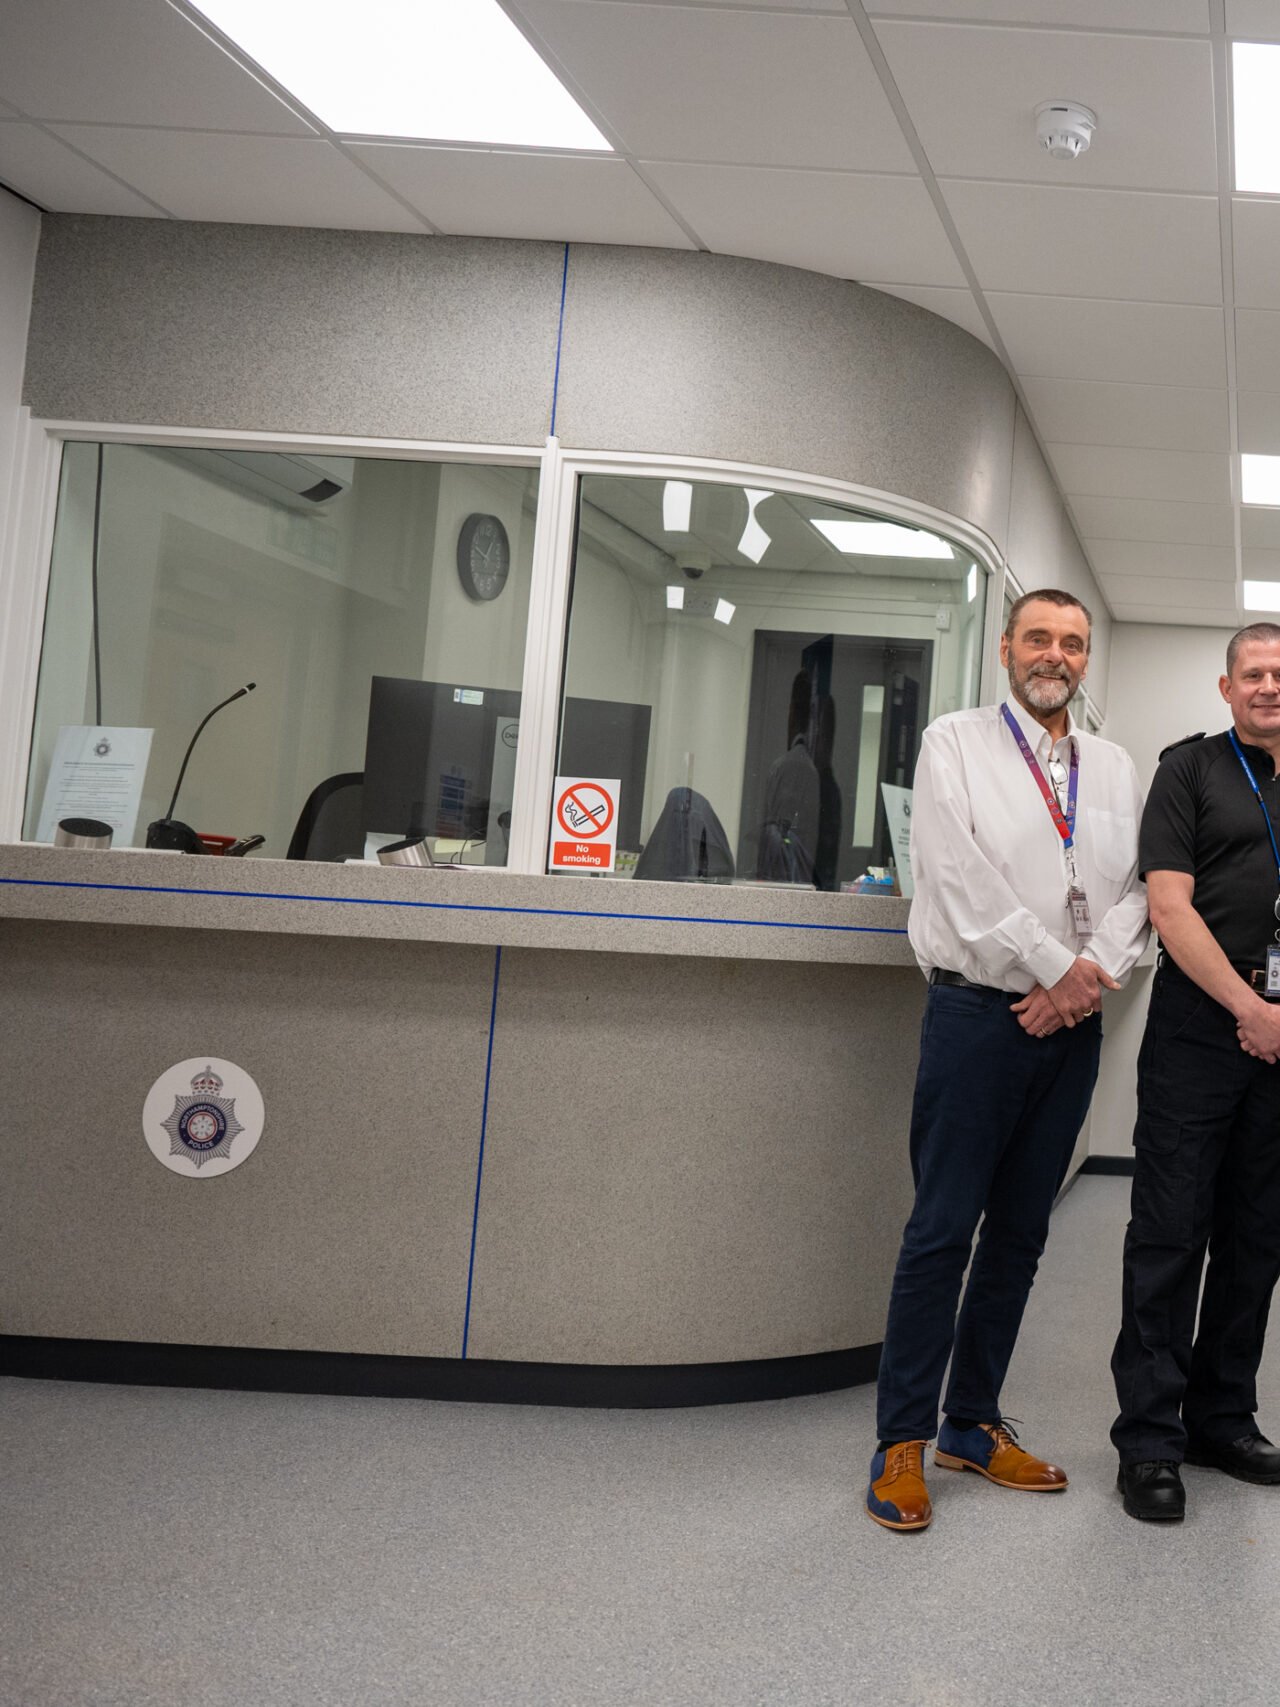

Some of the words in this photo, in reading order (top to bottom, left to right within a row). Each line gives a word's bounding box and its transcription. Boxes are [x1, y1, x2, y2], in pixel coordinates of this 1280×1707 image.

[576, 845, 589, 853] No
[562, 854, 601, 865] smoking
[181, 1105, 225, 1131] NORTHAMPTONSHIRE
[188, 1140, 214, 1149] POLICE
